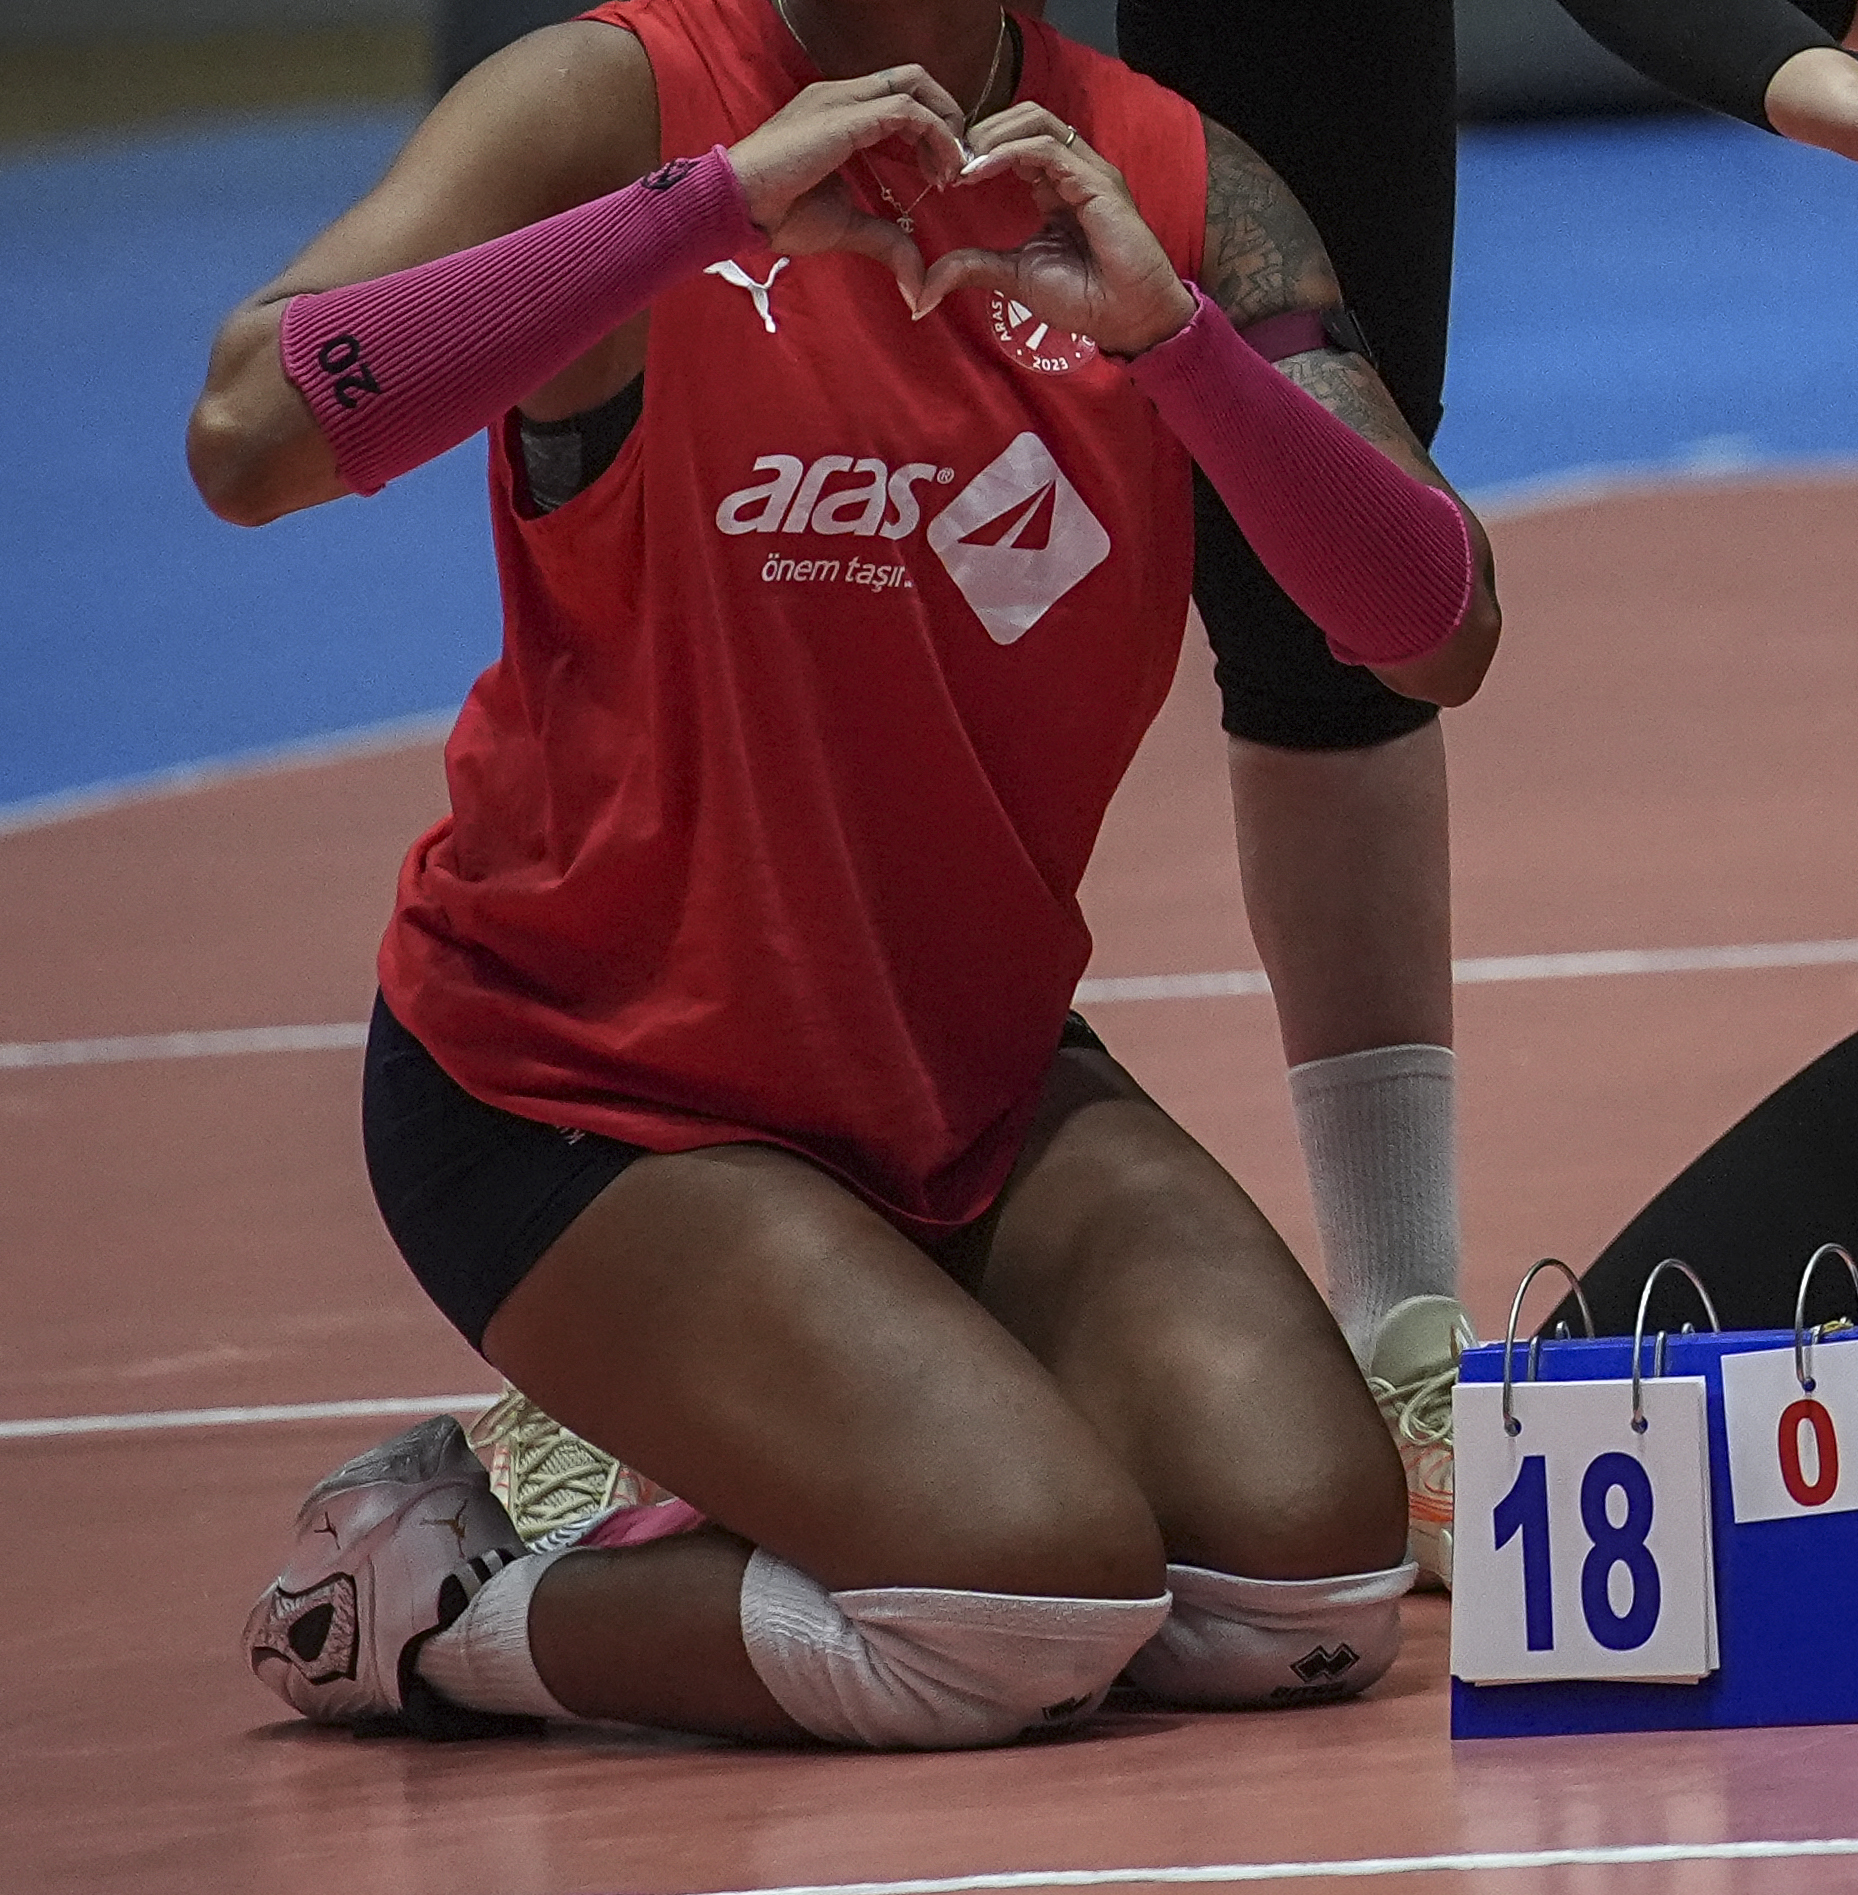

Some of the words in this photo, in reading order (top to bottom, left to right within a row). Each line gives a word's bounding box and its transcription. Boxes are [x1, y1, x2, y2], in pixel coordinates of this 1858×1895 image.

[991, 299, 1012, 341] ARAS
[319, 333, 382, 408] 20
[1032, 354, 1069, 371] 2023
[715, 454, 938, 541] aras
[760, 552, 840, 582] önem
[1777, 1398, 1840, 1507] 0
[1492, 1451, 1662, 1652] 18
